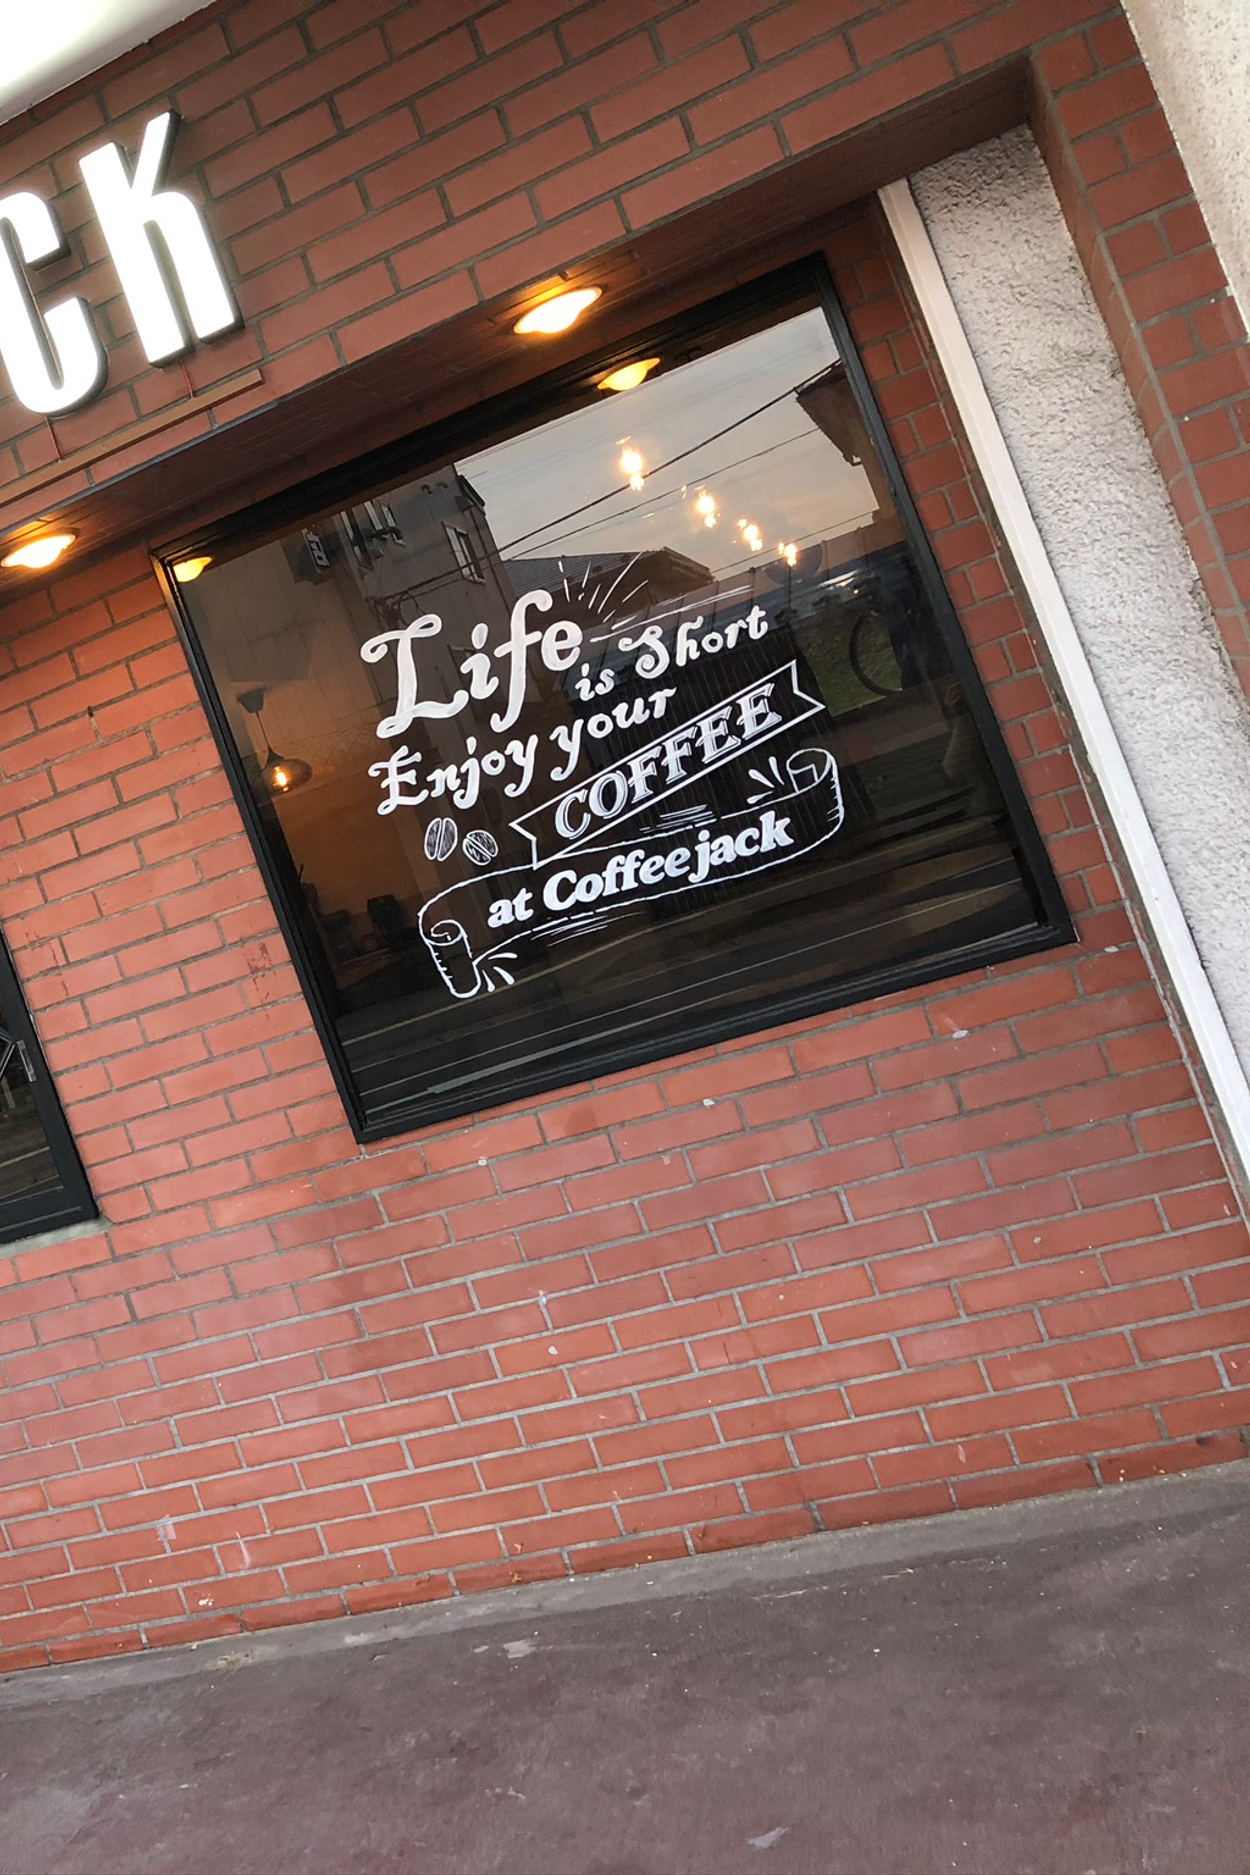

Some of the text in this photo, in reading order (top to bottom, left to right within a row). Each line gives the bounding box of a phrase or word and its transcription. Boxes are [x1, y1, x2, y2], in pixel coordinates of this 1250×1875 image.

[361, 590, 769, 739] Life is Short
[368, 686, 676, 816] Enjoy your
[554, 682, 782, 839] COFFEE
[487, 811, 795, 928] at Coffeejack
